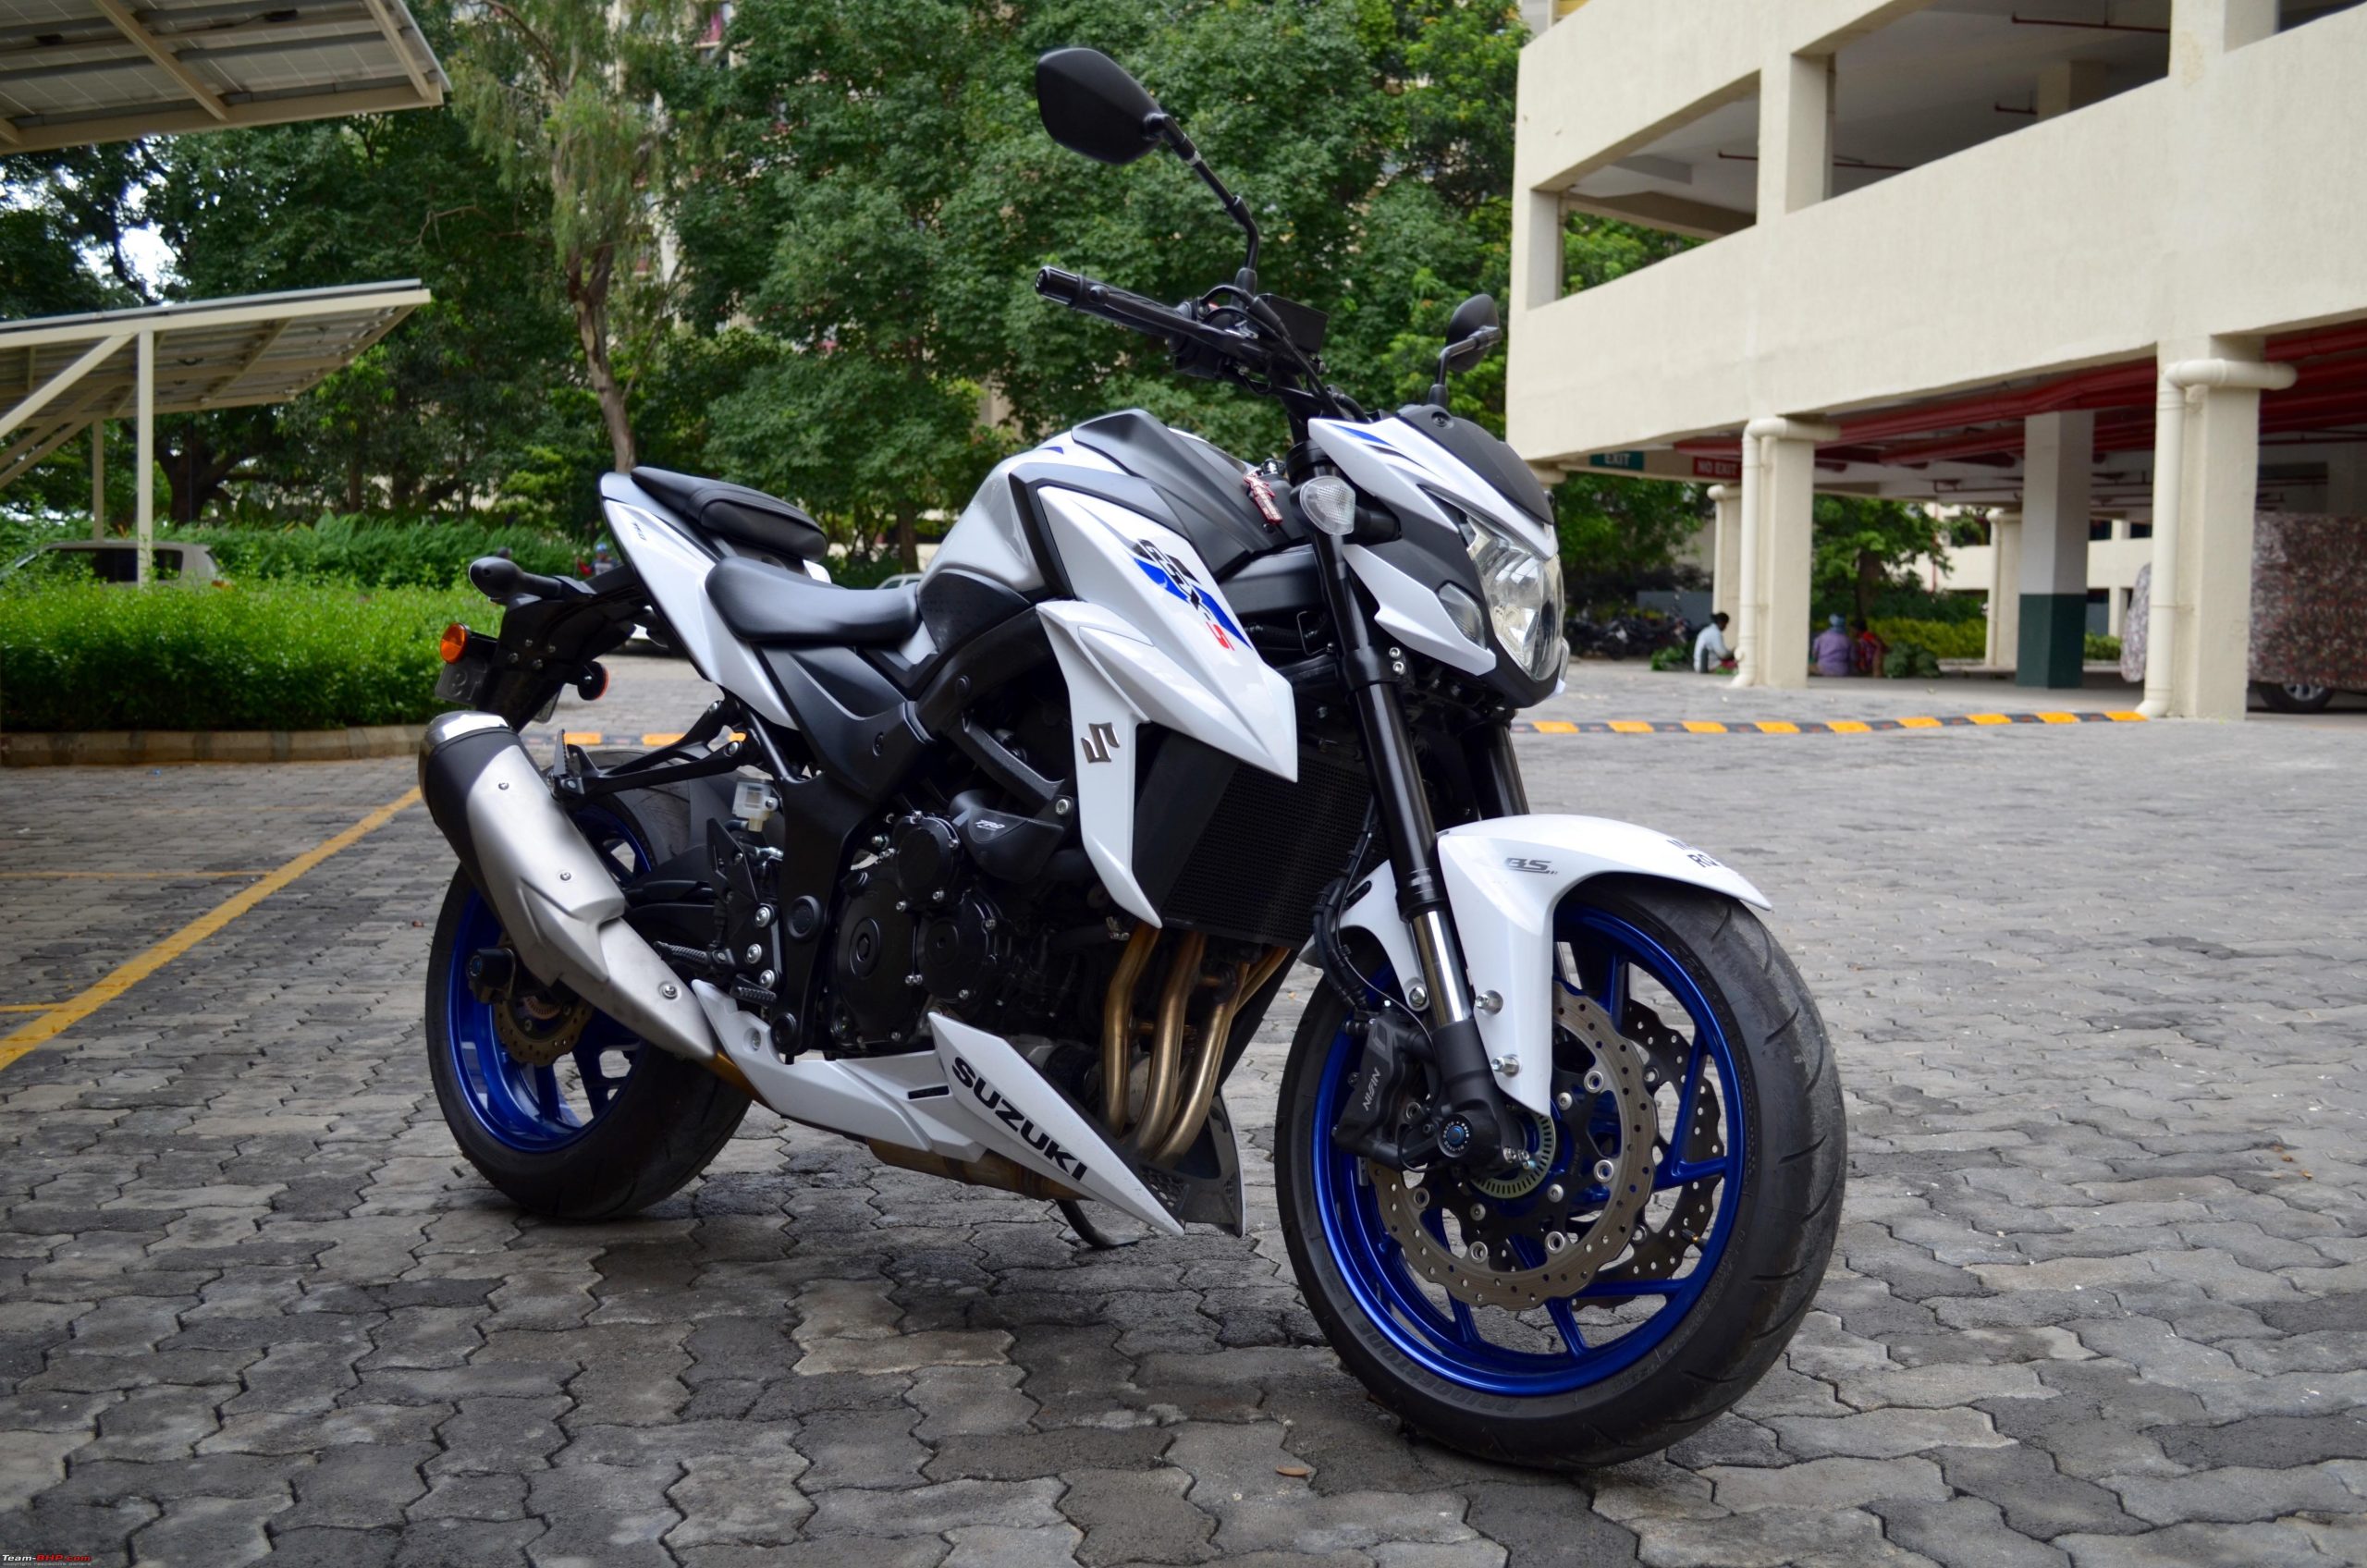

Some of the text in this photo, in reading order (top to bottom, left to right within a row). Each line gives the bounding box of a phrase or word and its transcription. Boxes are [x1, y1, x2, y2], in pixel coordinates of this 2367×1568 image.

[1604, 453, 1631, 466] EXIT
[1698, 460, 1737, 475] NO EXIT
[1362, 1067, 1381, 1111] NISSIN
[952, 1057, 1088, 1181] SUZUKI
[1355, 1321, 1521, 1413] BRIDGESTONE
